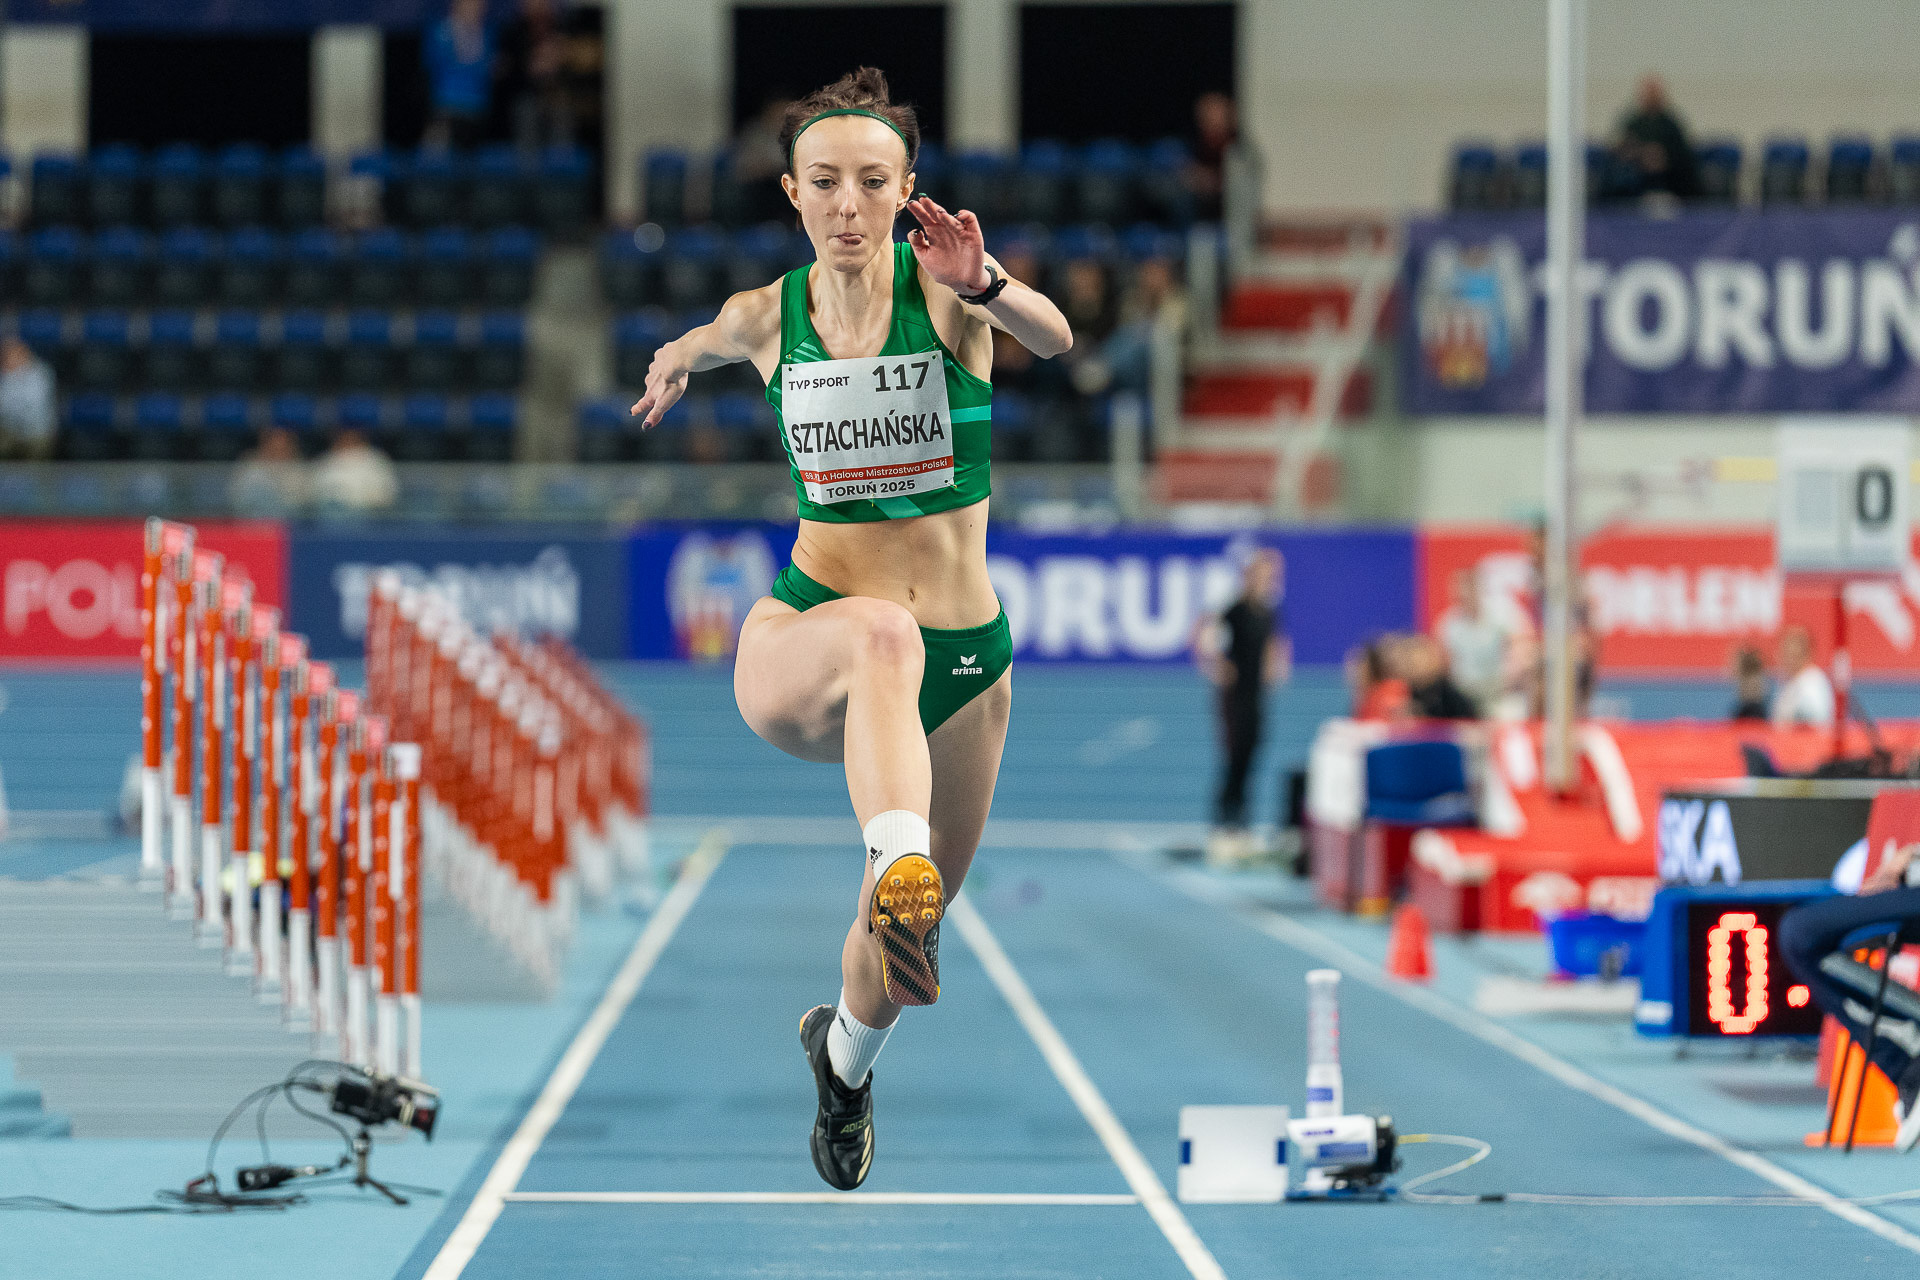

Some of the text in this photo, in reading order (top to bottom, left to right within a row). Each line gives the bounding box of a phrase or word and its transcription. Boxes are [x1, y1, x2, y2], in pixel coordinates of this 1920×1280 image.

[788, 375, 850, 391] TVP SPORT
[872, 361, 929, 392] 117
[791, 408, 945, 453] SZTACHAŃSKA
[829, 470, 864, 480] Halowe
[866, 465, 920, 477] Mistrzostwa
[922, 458, 948, 471] Polski
[826, 479, 916, 499] TORUŃ 2025
[1855, 467, 1893, 526] 0
[952, 666, 983, 675] erima
